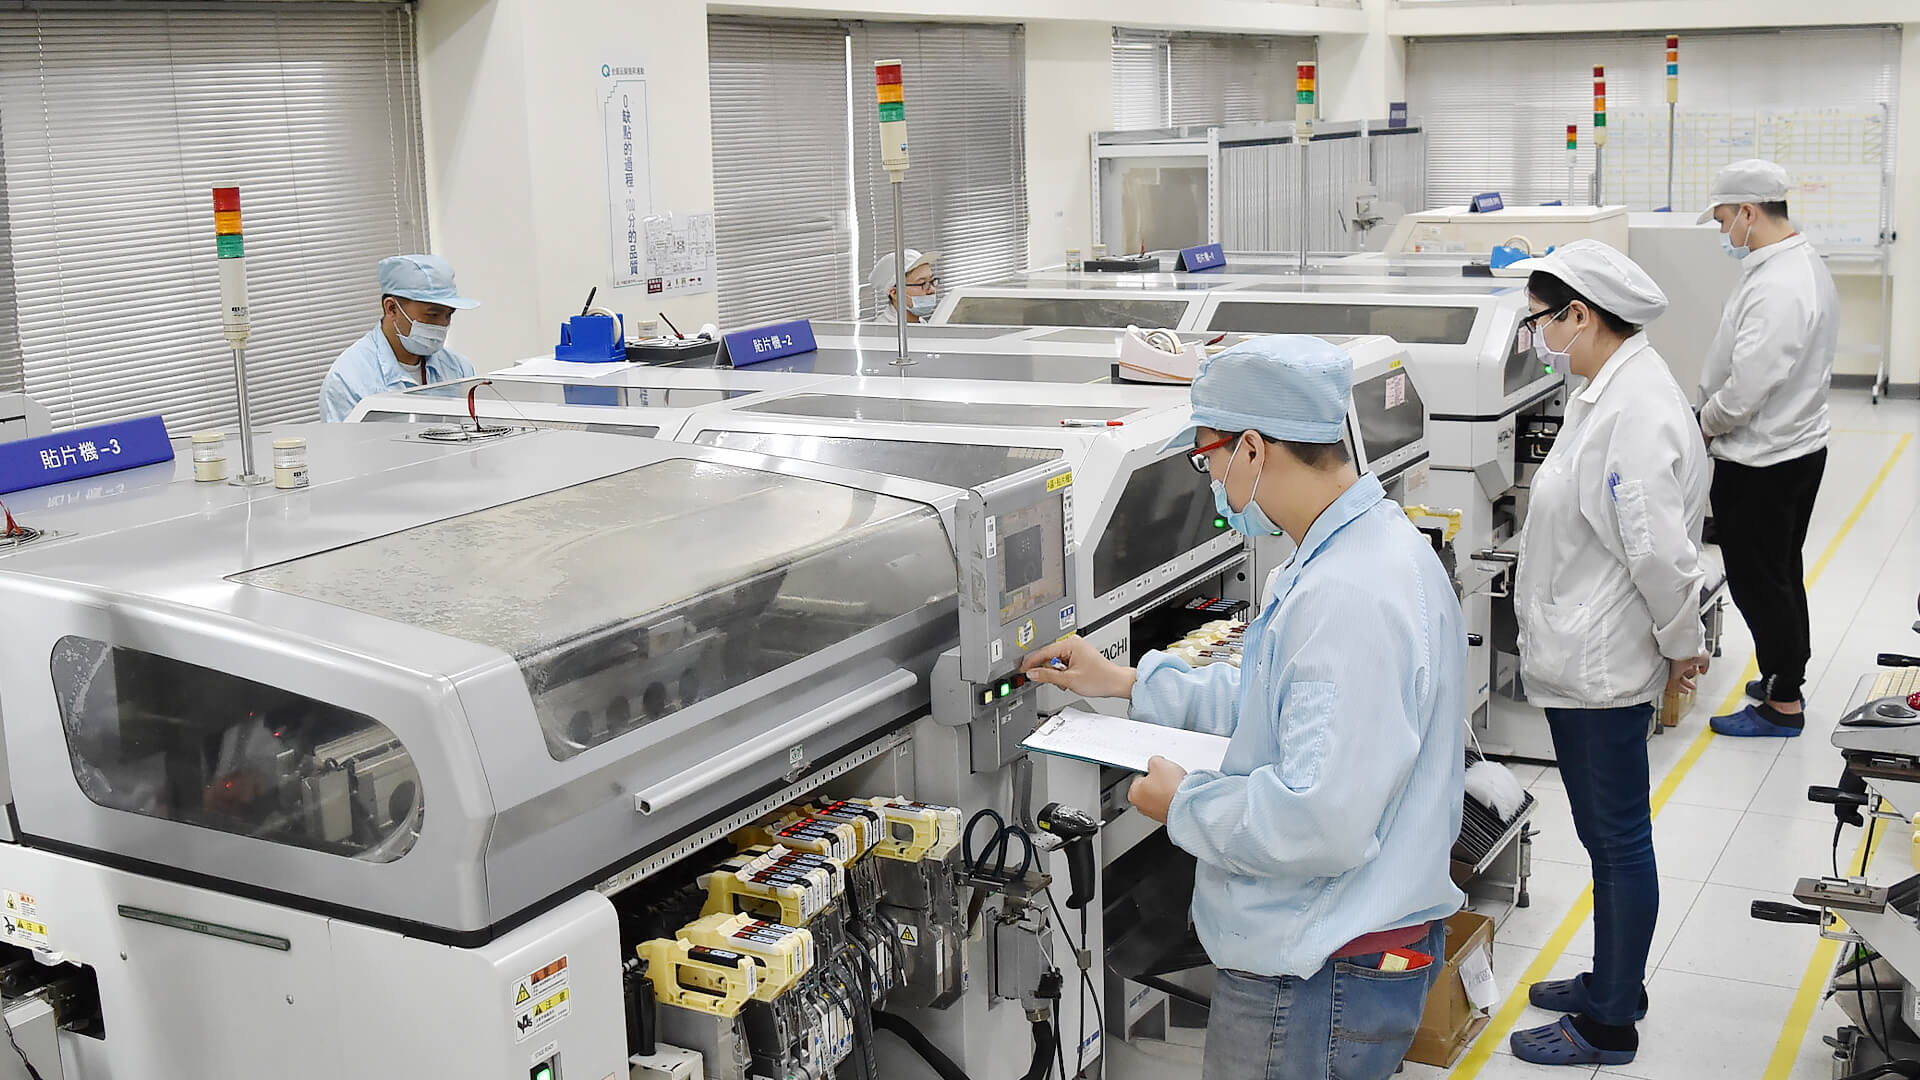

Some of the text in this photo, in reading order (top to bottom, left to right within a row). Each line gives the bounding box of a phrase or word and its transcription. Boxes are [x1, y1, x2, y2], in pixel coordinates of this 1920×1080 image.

[752, 334, 793, 353] 貼片機-2
[39, 438, 121, 470] 貼片機-3
